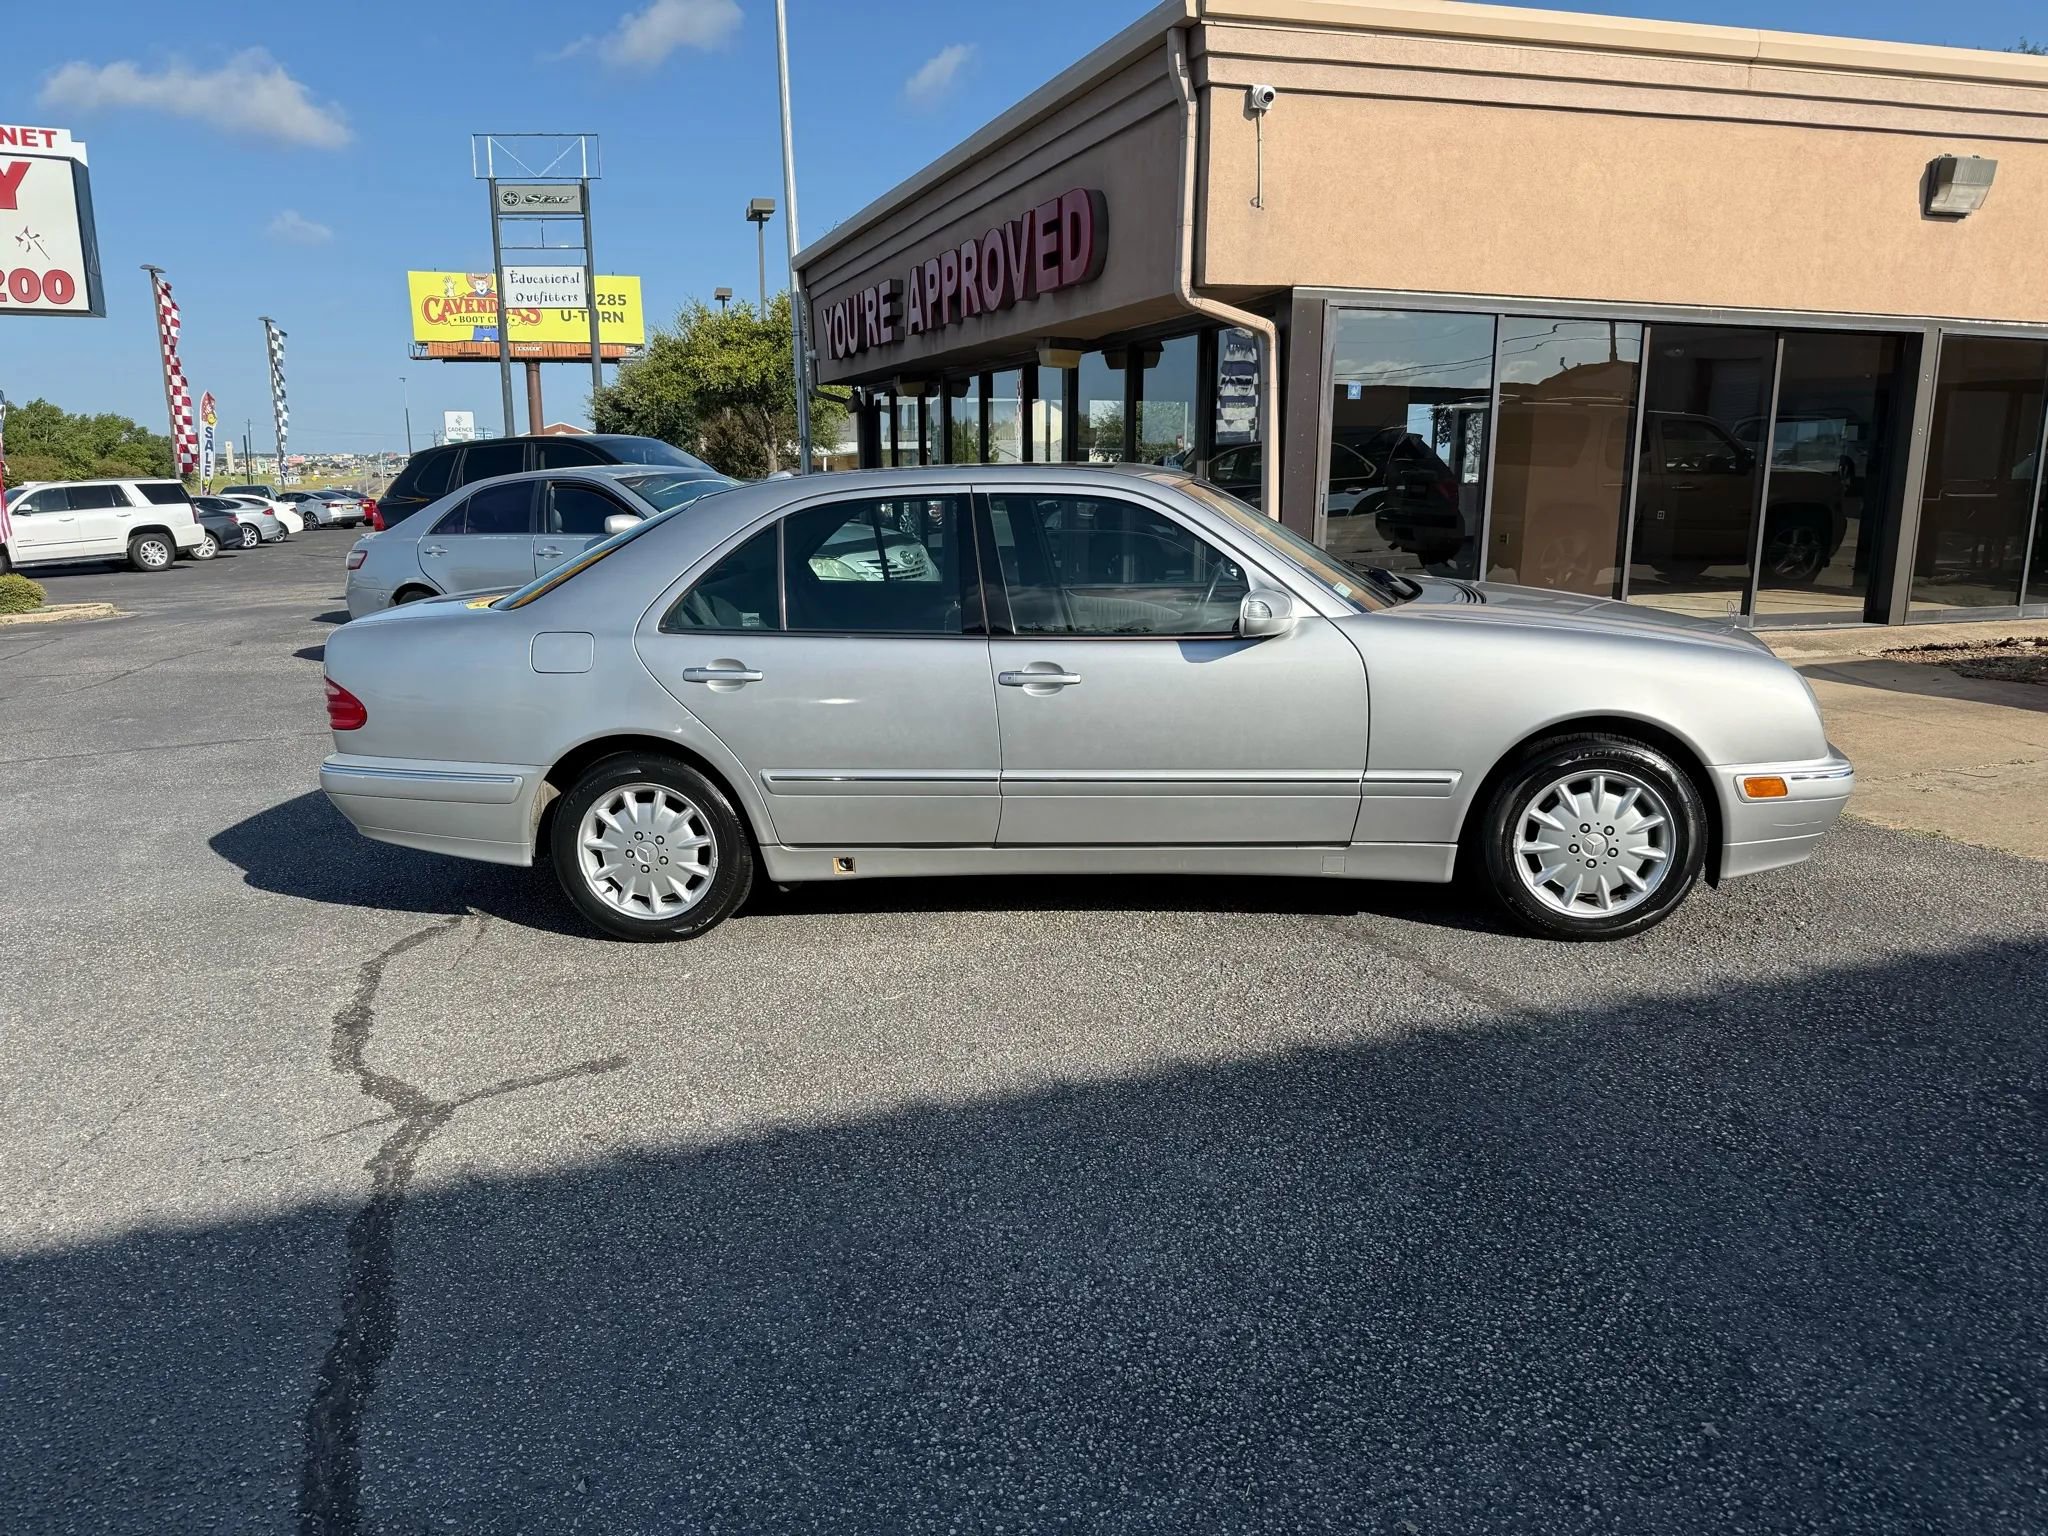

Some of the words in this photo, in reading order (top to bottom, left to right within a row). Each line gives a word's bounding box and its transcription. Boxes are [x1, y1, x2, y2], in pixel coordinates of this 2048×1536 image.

[0, 127, 58, 149] NET
[510, 270, 580, 284] Educational
[822, 279, 896, 360] YOU'RE
[907, 188, 1096, 336] APPROVED
[0, 267, 76, 305] 00
[515, 291, 579, 305] Outfitters
[597, 293, 627, 306] 285
[459, 315, 485, 324] BOOT
[560, 310, 625, 323] U-TRN
[205, 426, 214, 477] SALE
